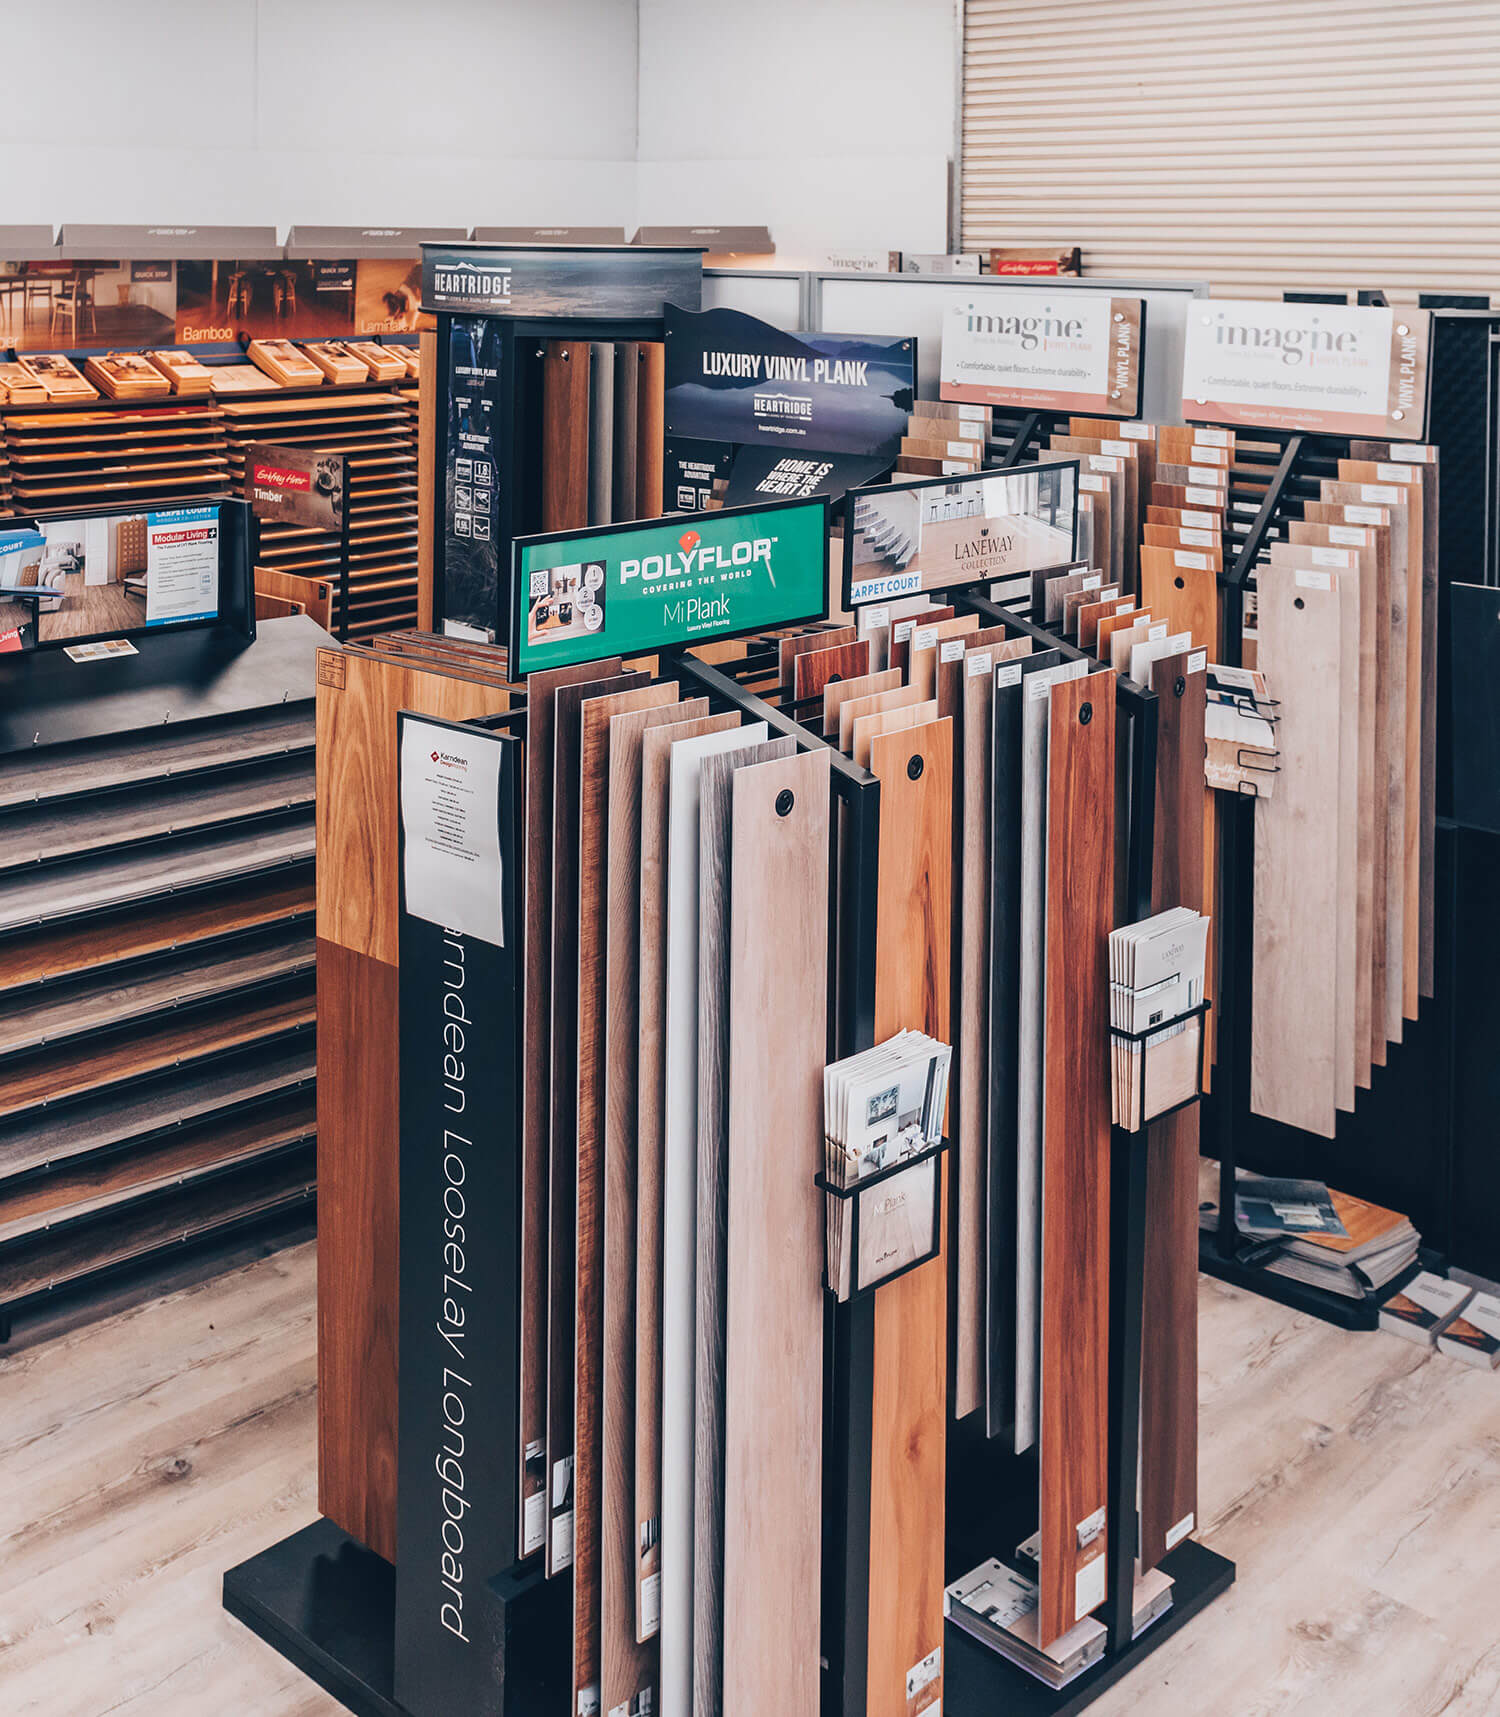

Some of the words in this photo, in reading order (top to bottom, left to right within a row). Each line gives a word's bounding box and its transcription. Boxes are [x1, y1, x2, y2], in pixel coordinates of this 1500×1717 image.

[434, 272, 512, 295] HEARTRIDGE
[183, 325, 233, 342] Bamboo
[1117, 322, 1131, 357] PLANK
[1400, 336, 1417, 375] PLANK
[702, 351, 761, 378] LUXURY
[763, 355, 812, 382] VINYL
[813, 359, 869, 387] PLANK
[1115, 359, 1130, 389] VINYL
[1398, 375, 1416, 409] VINYL
[754, 398, 812, 416] HEARTRIDGE
[774, 458, 819, 474] HOME
[813, 462, 835, 477] IS
[754, 479, 803, 495] HEART
[796, 483, 816, 497] IS
[766, 470, 803, 484] WHERE
[801, 474, 825, 487] THE
[253, 487, 283, 503] Timber
[154, 532, 186, 544] Modular
[186, 529, 209, 542] Living
[954, 535, 1015, 560] LANEWAY
[961, 554, 1008, 571] COLLECTION
[642, 579, 693, 595] COVERING
[698, 575, 715, 585] THE
[720, 569, 752, 581] WORLD
[887, 575, 920, 592] COURT
[0, 630, 18, 642] iving
[440, 752, 468, 766] Karndean
[436, 1129, 473, 1360] LooseLay
[434, 1367, 473, 1644] Longboard
